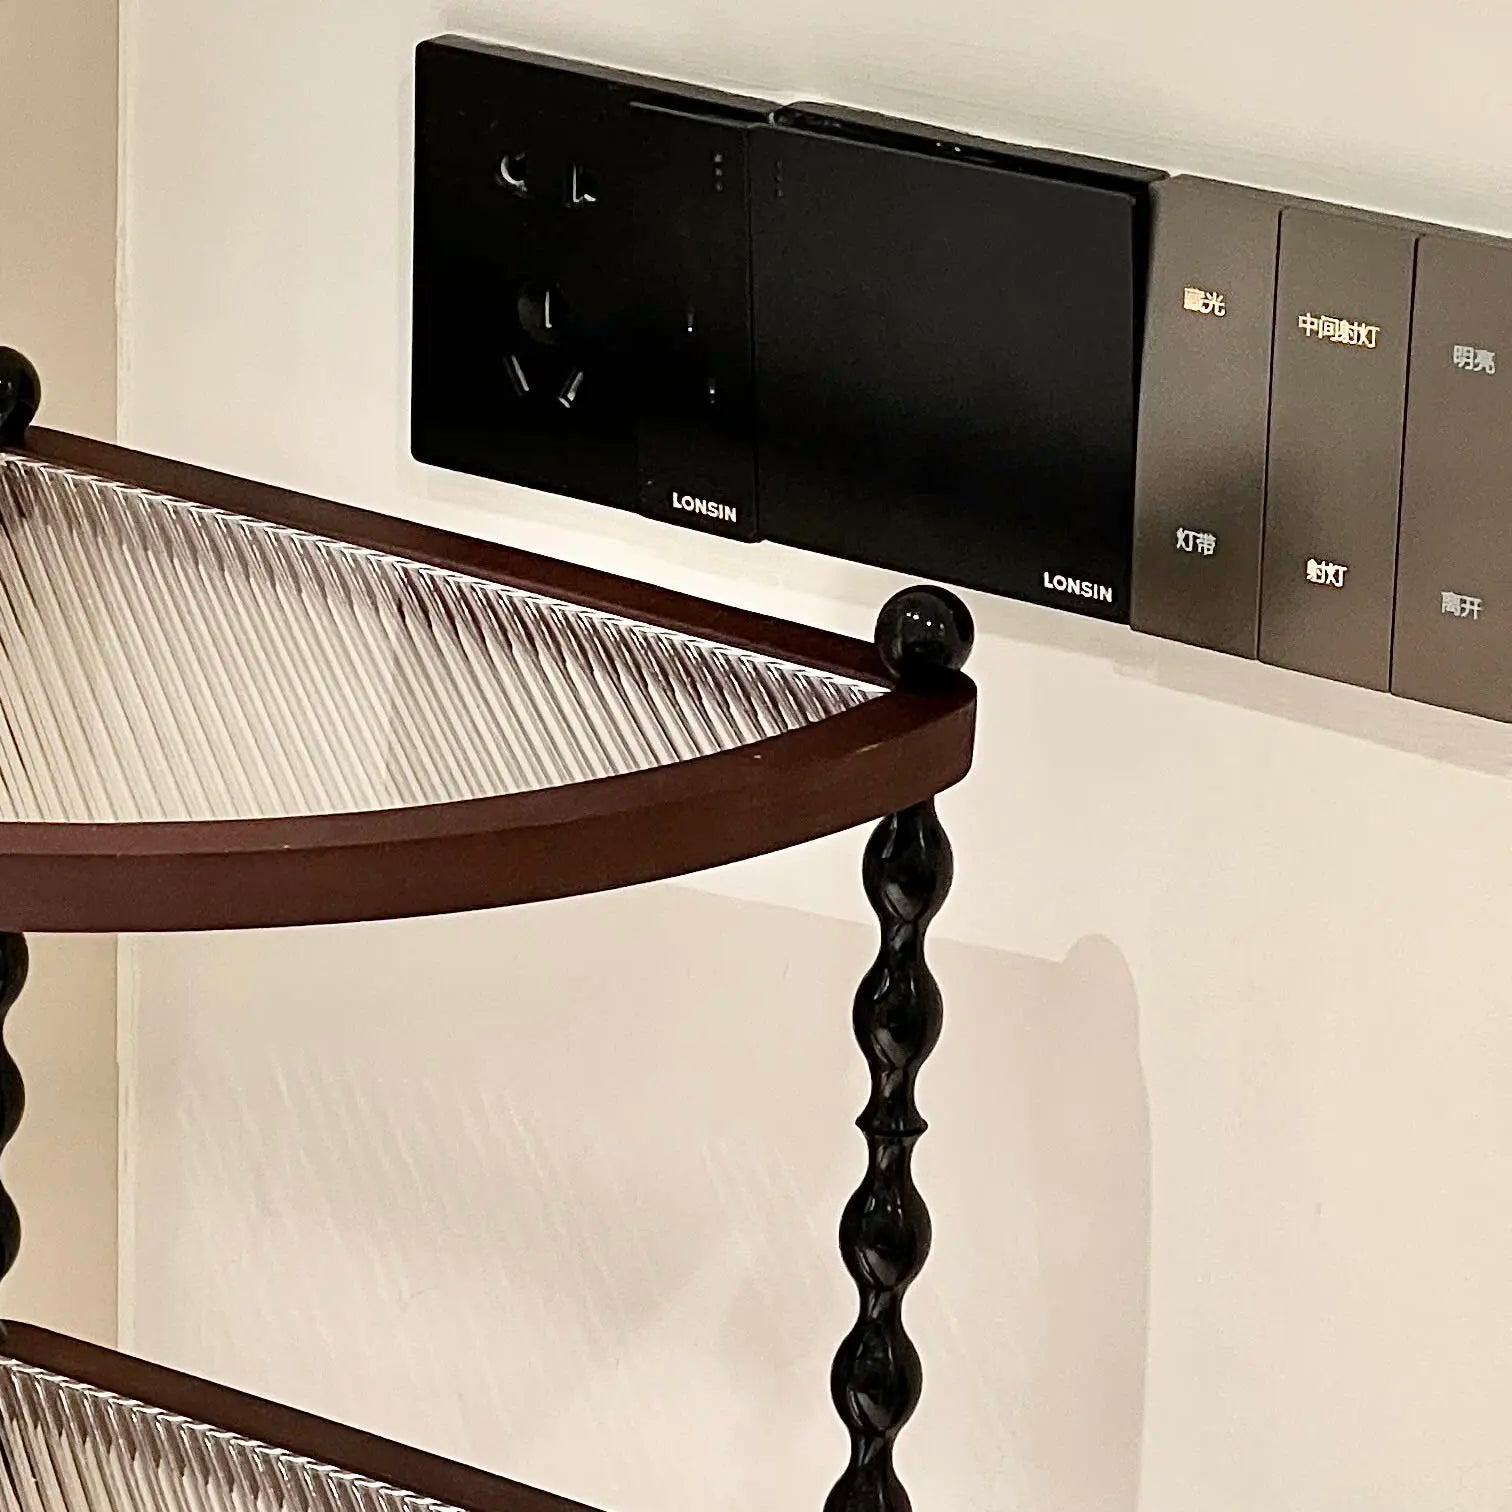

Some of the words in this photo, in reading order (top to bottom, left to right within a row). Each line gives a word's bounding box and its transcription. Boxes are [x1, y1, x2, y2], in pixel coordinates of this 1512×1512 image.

[1297, 312, 1381, 349] 中间射灯
[1453, 344, 1496, 375] 明亮
[672, 491, 737, 523] LONSIN
[1176, 527, 1217, 556] 灯带
[1043, 571, 1113, 603] LONSIN
[1306, 557, 1348, 588] 射灯
[1440, 591, 1483, 621] 离开
